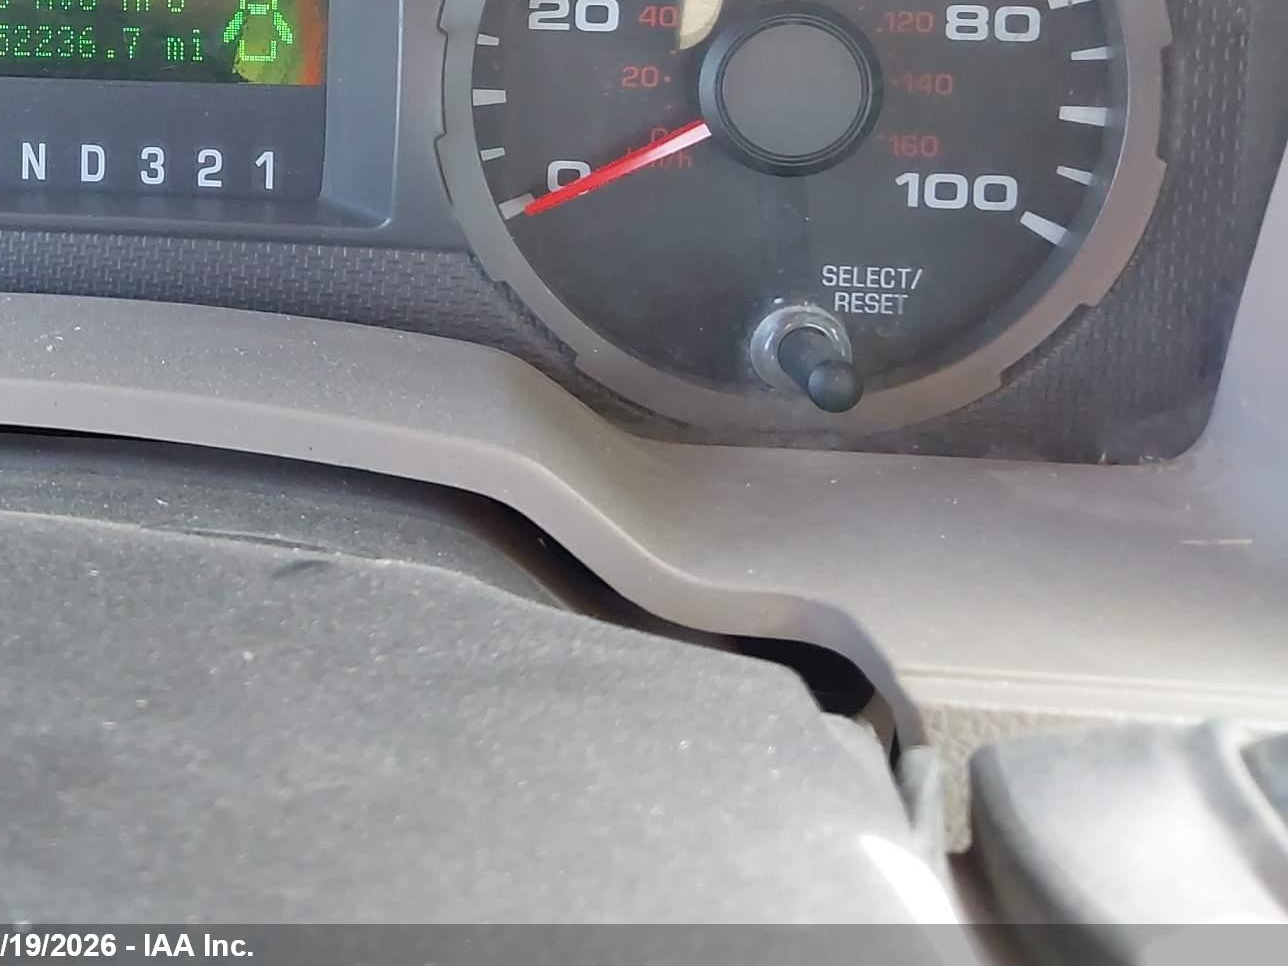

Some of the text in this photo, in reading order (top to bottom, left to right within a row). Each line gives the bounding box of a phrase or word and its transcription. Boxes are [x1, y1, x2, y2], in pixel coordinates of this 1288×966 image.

[639, 5, 678, 27] 40
[884, 9, 935, 33] 120
[946, 5, 1040, 41] 80
[166, 28, 203, 61] mi
[621, 65, 659, 87] 20
[903, 73, 953, 95] 140
[889, 135, 939, 157] 160
[22, 143, 45, 179] N
[81, 145, 105, 181] D
[141, 147, 164, 184] 3
[198, 149, 222, 187] 2
[256, 152, 273, 189] 1
[548, 161, 590, 195] 0
[895, 173, 1017, 210] 100
[822, 264, 923, 290] SELECT/
[833, 291, 910, 315] RESET
